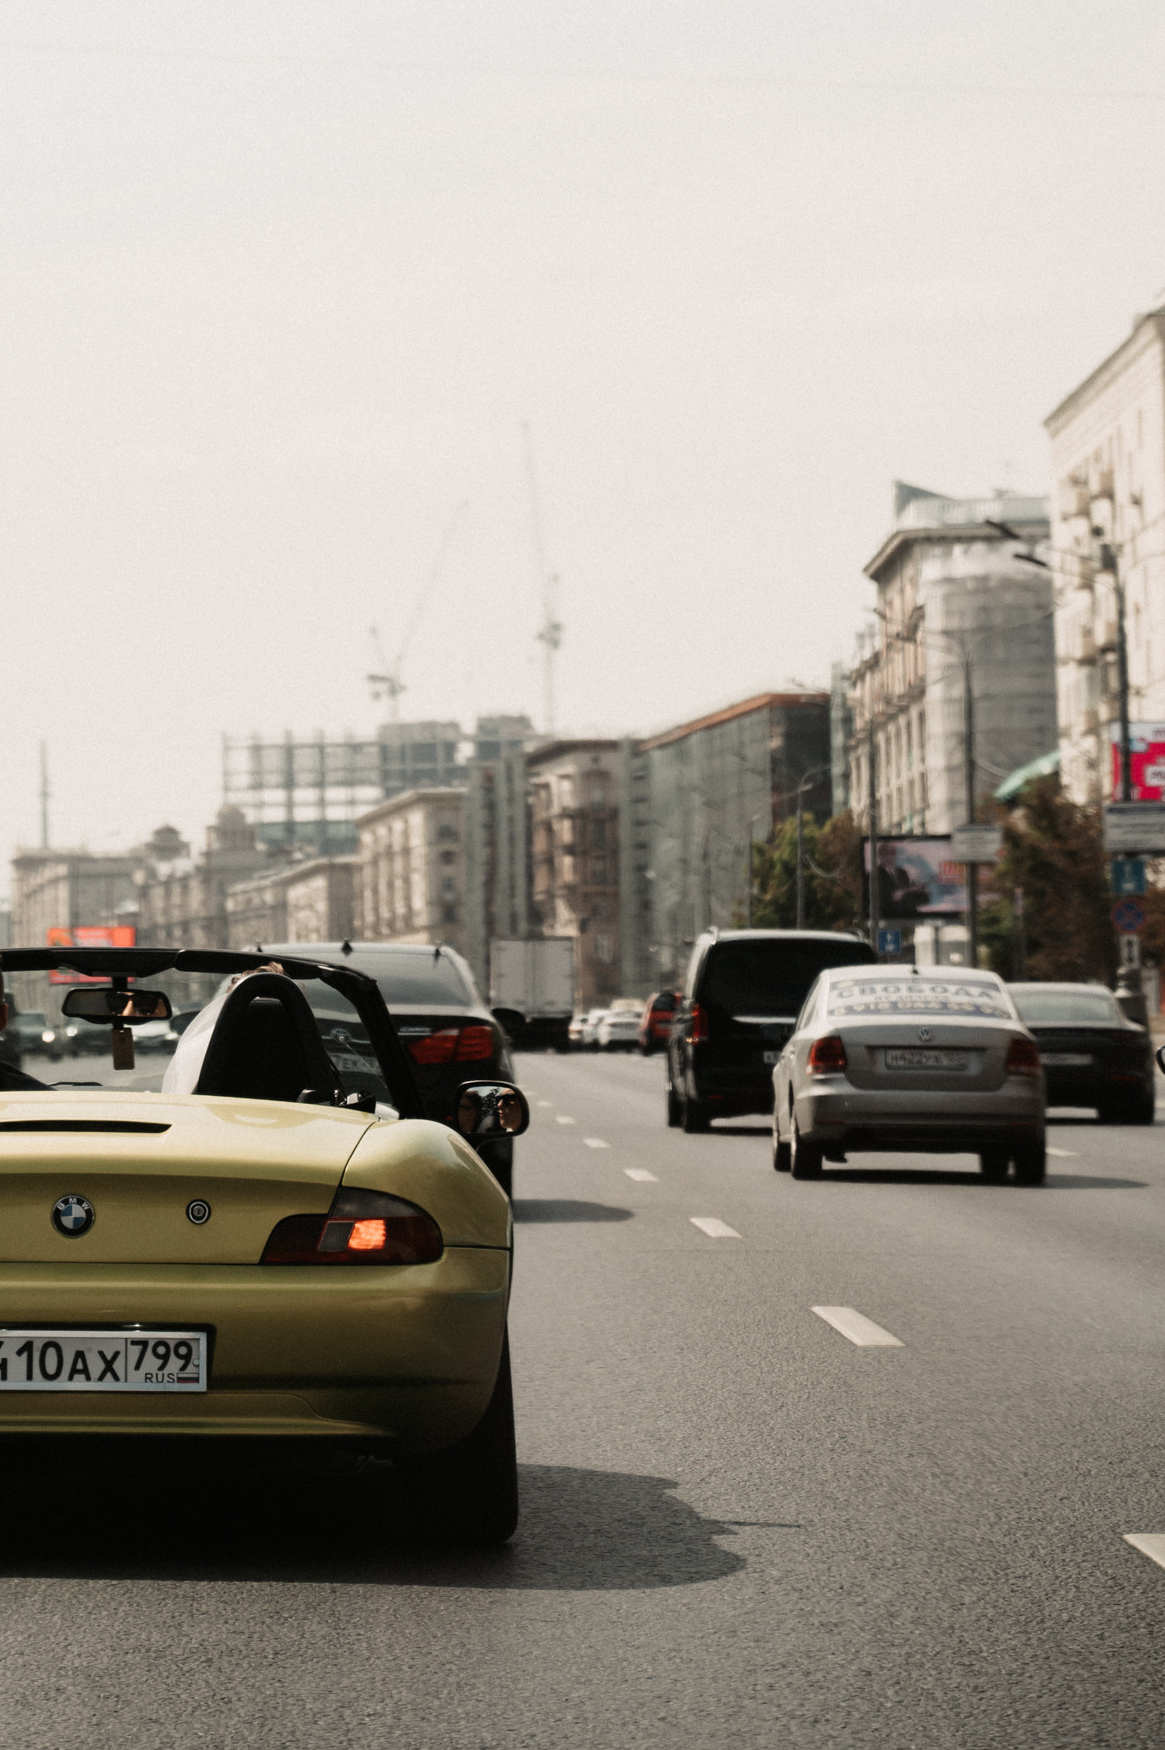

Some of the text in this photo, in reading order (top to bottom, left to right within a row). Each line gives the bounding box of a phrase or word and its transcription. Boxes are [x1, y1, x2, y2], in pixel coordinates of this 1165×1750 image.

[836, 985, 994, 1000] СВОБОДА
[130, 1340, 194, 1372] 799
[145, 1373, 176, 1384] RUS
